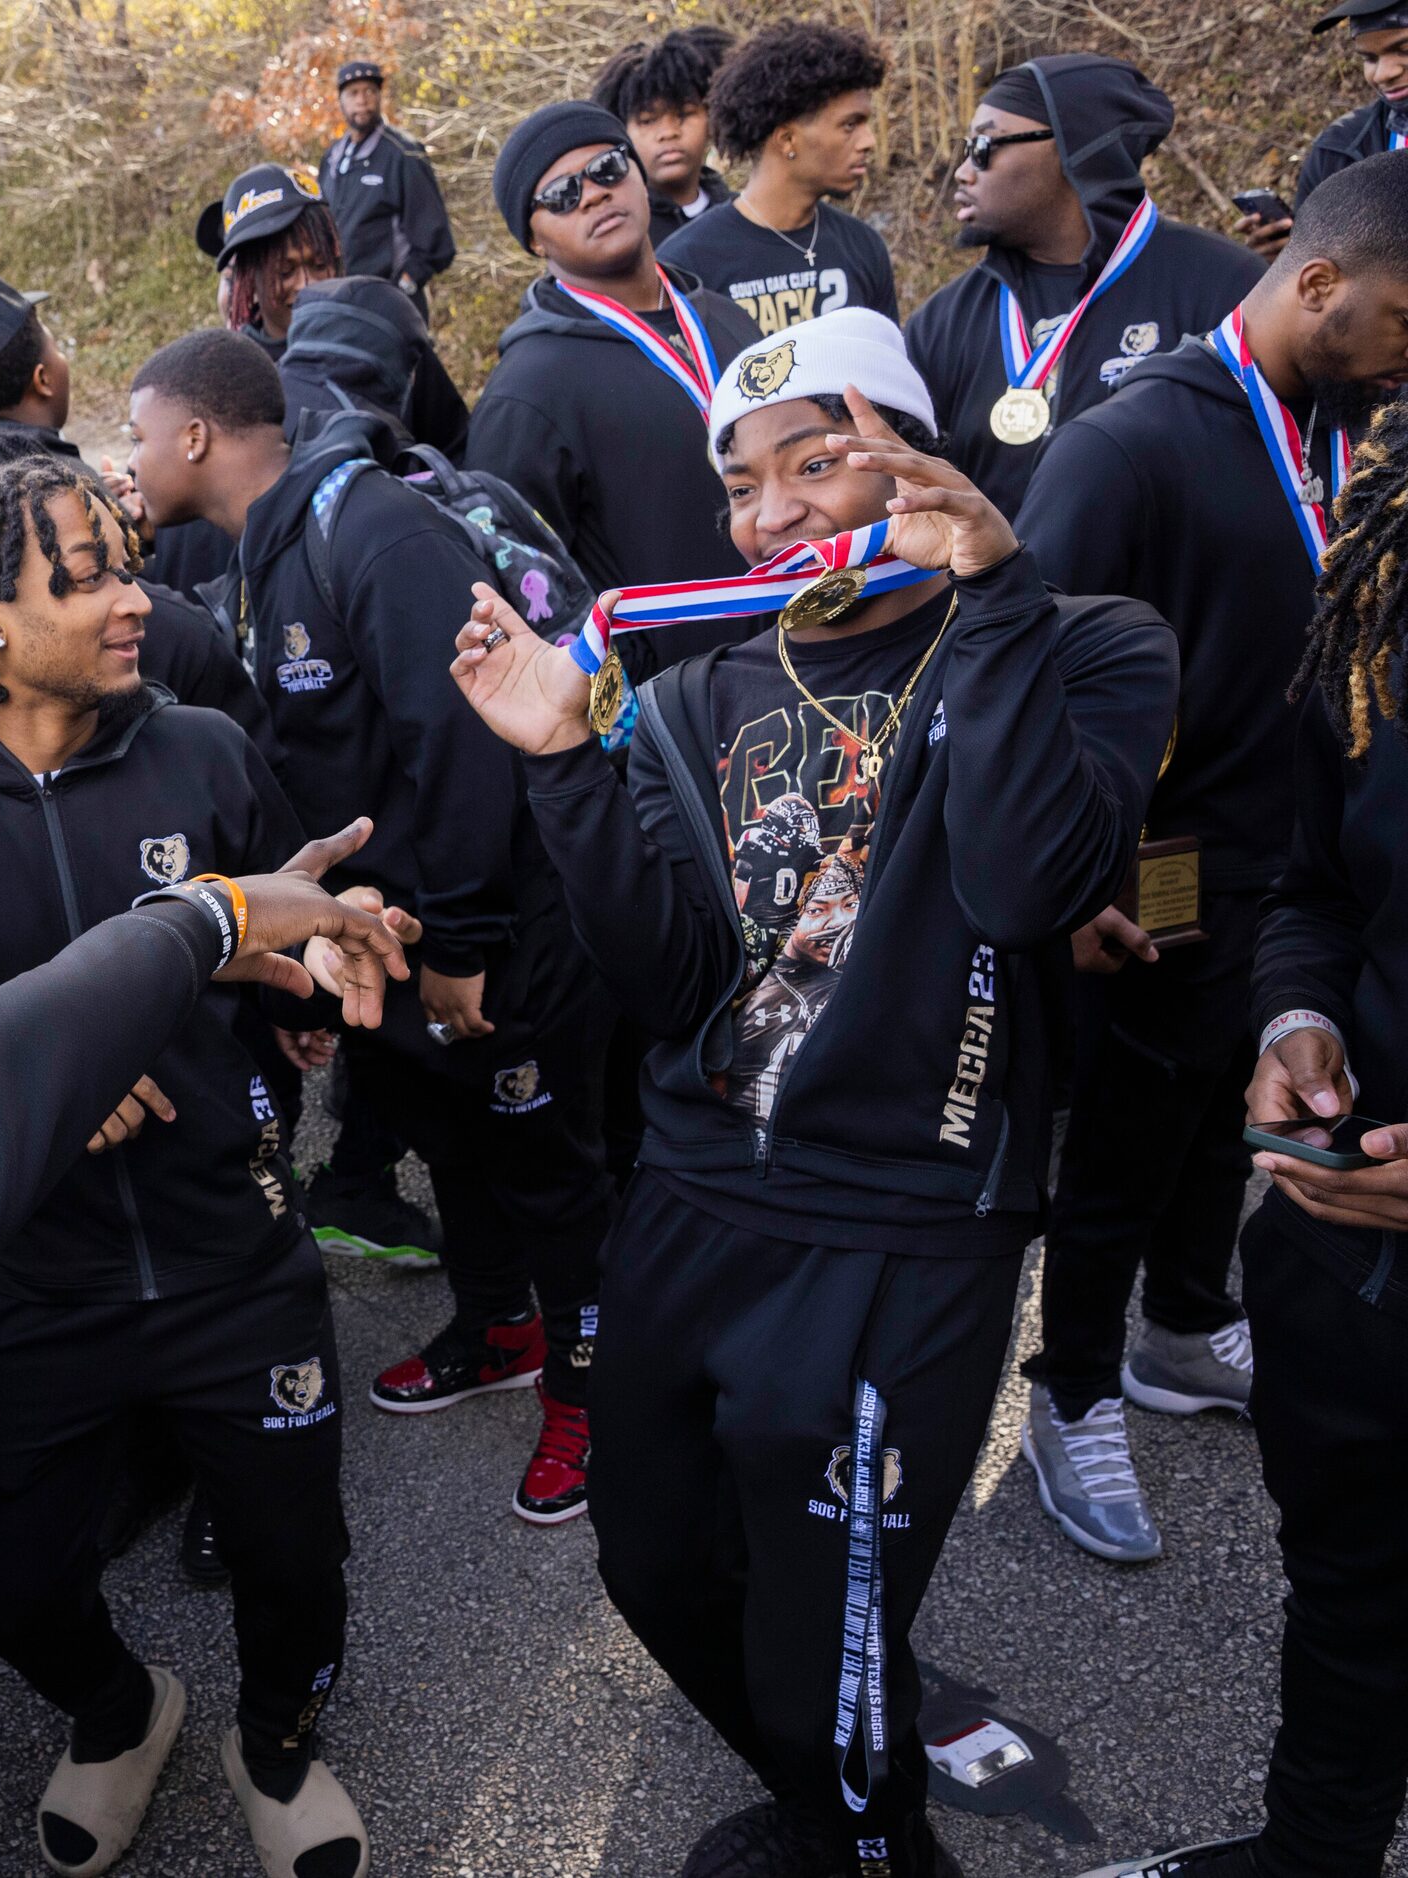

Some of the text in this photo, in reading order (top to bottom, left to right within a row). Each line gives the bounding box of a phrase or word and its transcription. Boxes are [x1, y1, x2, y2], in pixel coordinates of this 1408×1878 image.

[729, 270, 817, 299] SOUTH OAK CLIFF
[276, 659, 334, 689] SOC
[198, 889, 231, 937] BRAKES.
[222, 934, 233, 955] NO
[939, 943, 995, 1149] MECCA 23
[263, 1401, 336, 1429] SOC FOOTBALL
[857, 1418, 874, 1460] TEXAS
[808, 1499, 836, 1520] SOC
[847, 1577, 869, 1610] DONE
[839, 1670, 861, 1704] DONE
[868, 1662, 882, 1706] TEXAS
[871, 1707, 884, 1751] AGGIES
